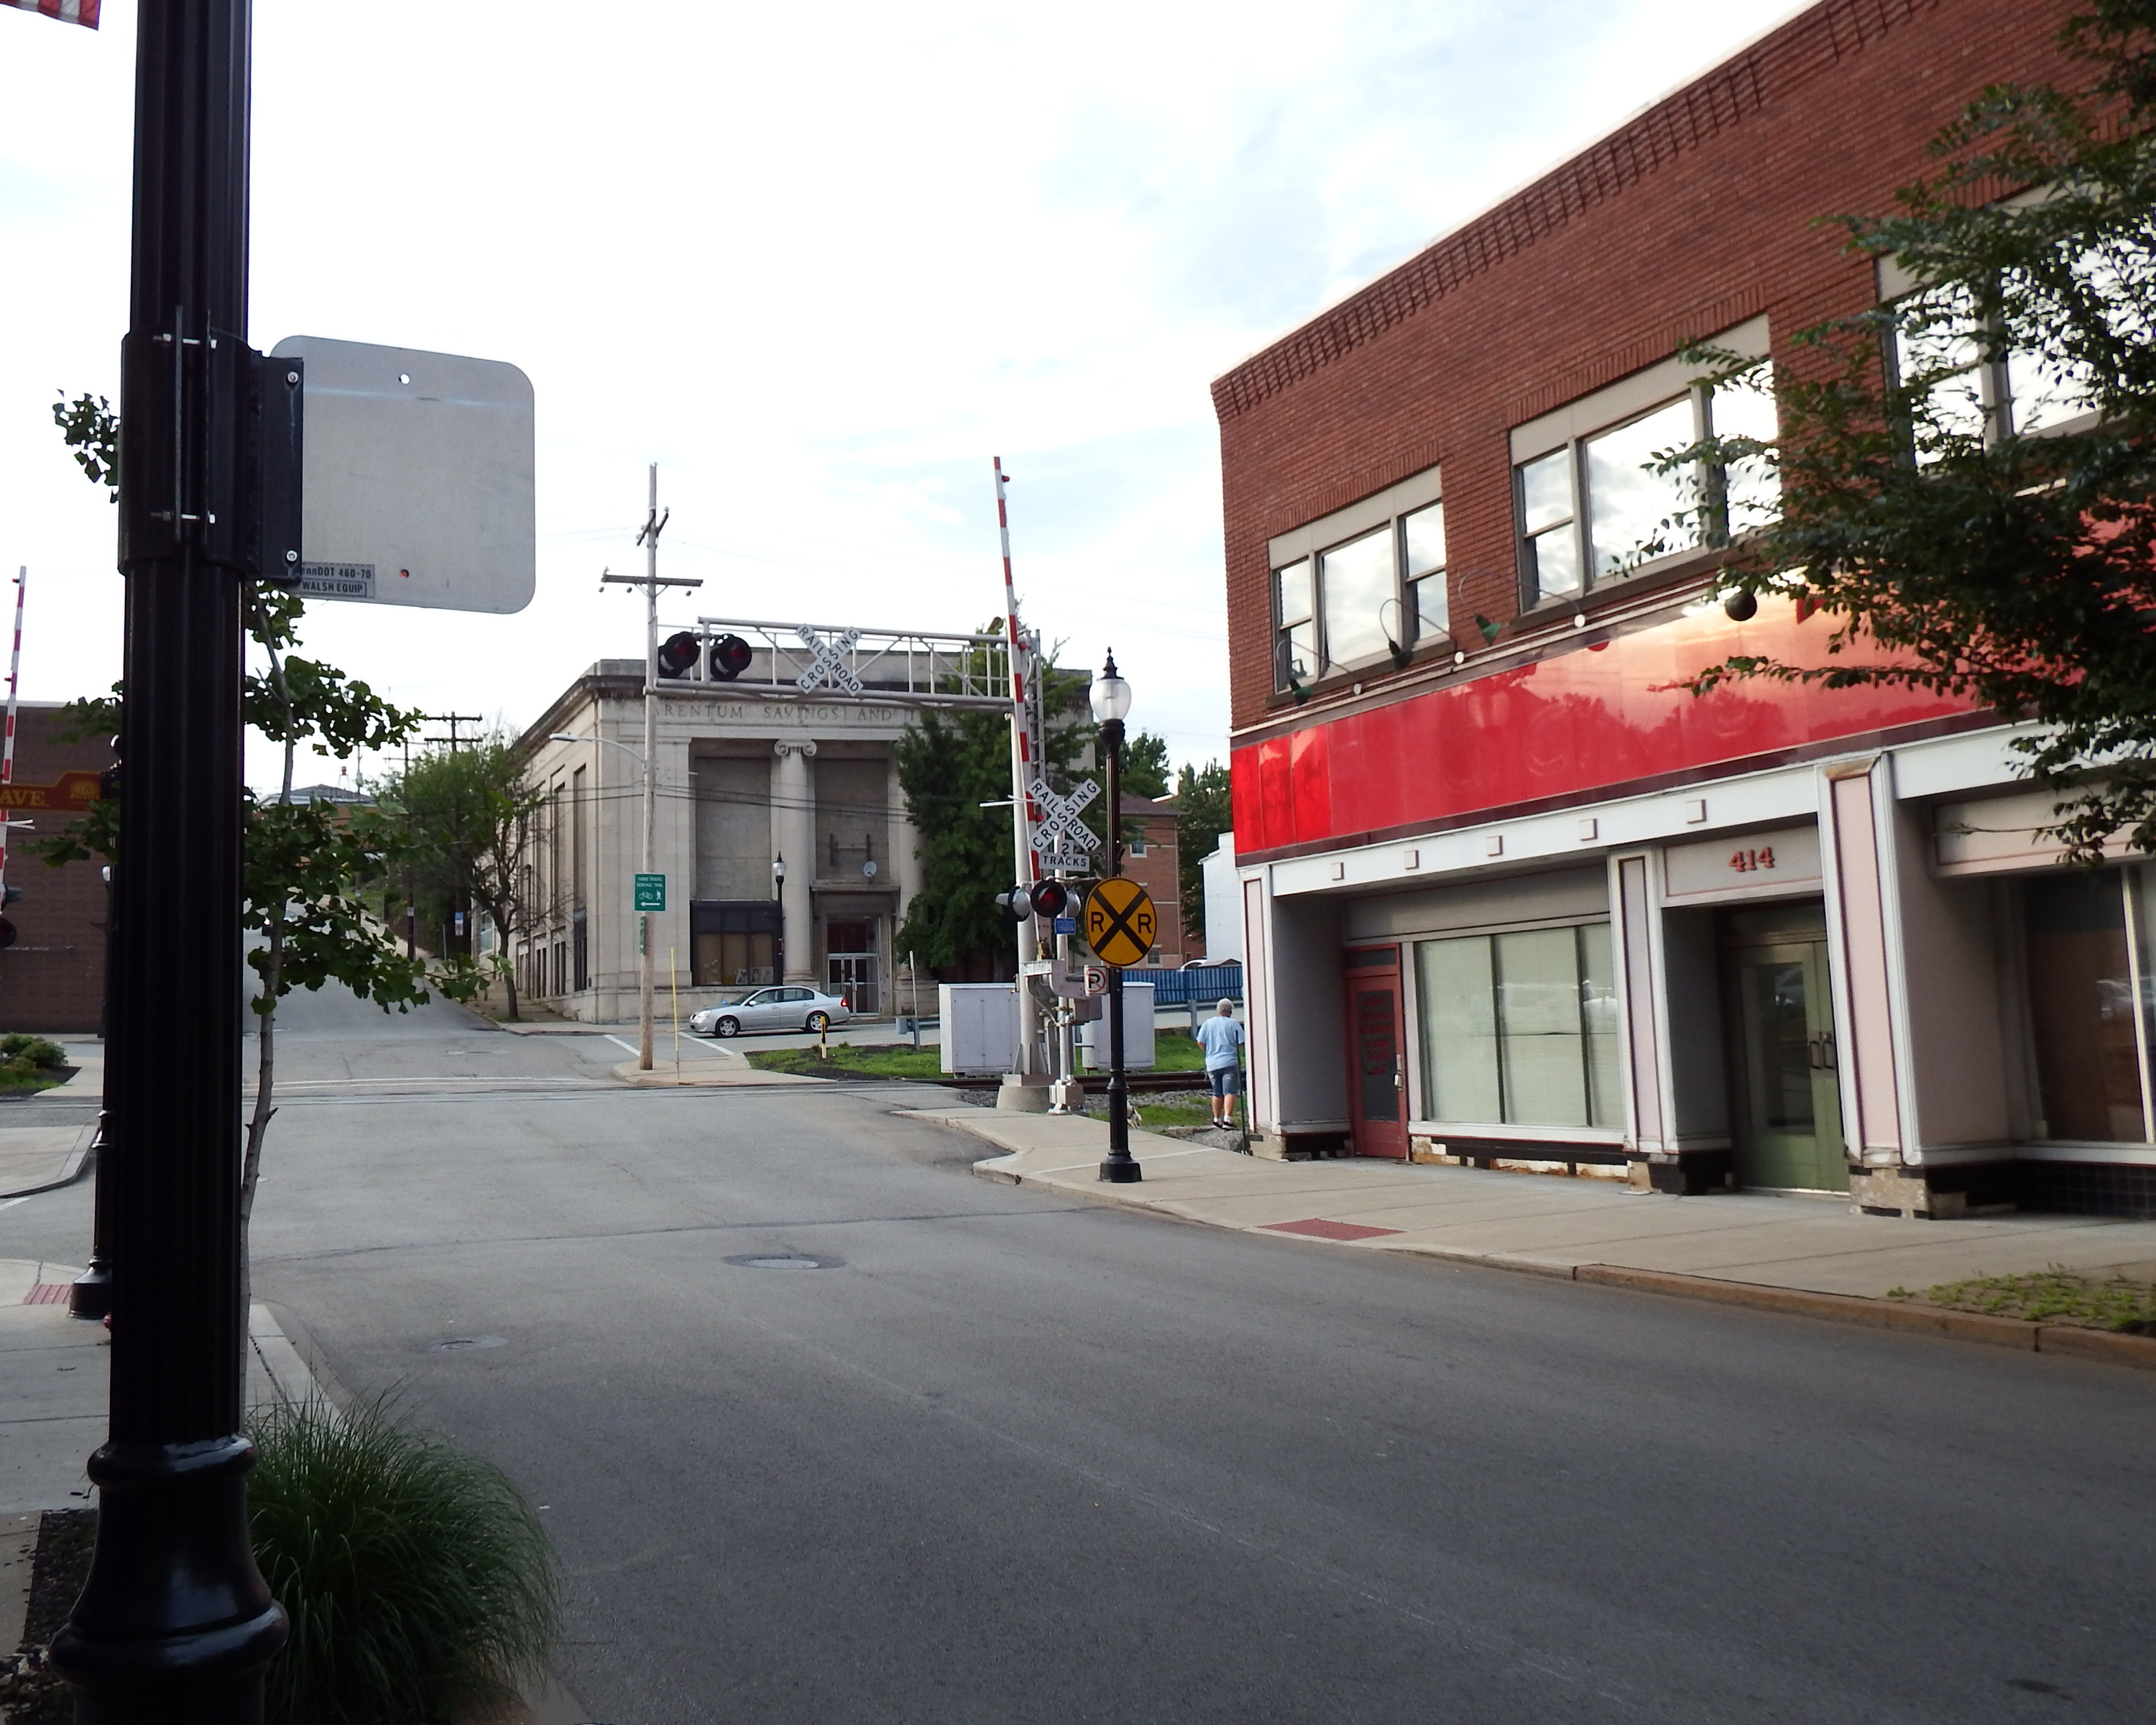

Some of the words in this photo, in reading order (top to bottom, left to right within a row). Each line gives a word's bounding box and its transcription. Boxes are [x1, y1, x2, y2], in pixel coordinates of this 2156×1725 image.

[338, 568, 372, 579] 460-70
[303, 581, 334, 592] WALSH
[336, 583, 363, 593] EQUIP
[800, 630, 858, 690] CROSSING
[763, 706, 838, 720] SAVINGS
[857, 707, 892, 721] AND
[1033, 783, 1097, 848] CROSSING
[1061, 842, 1069, 855] 2
[1043, 855, 1087, 867] TRACKS
[1728, 847, 1775, 872] 414
